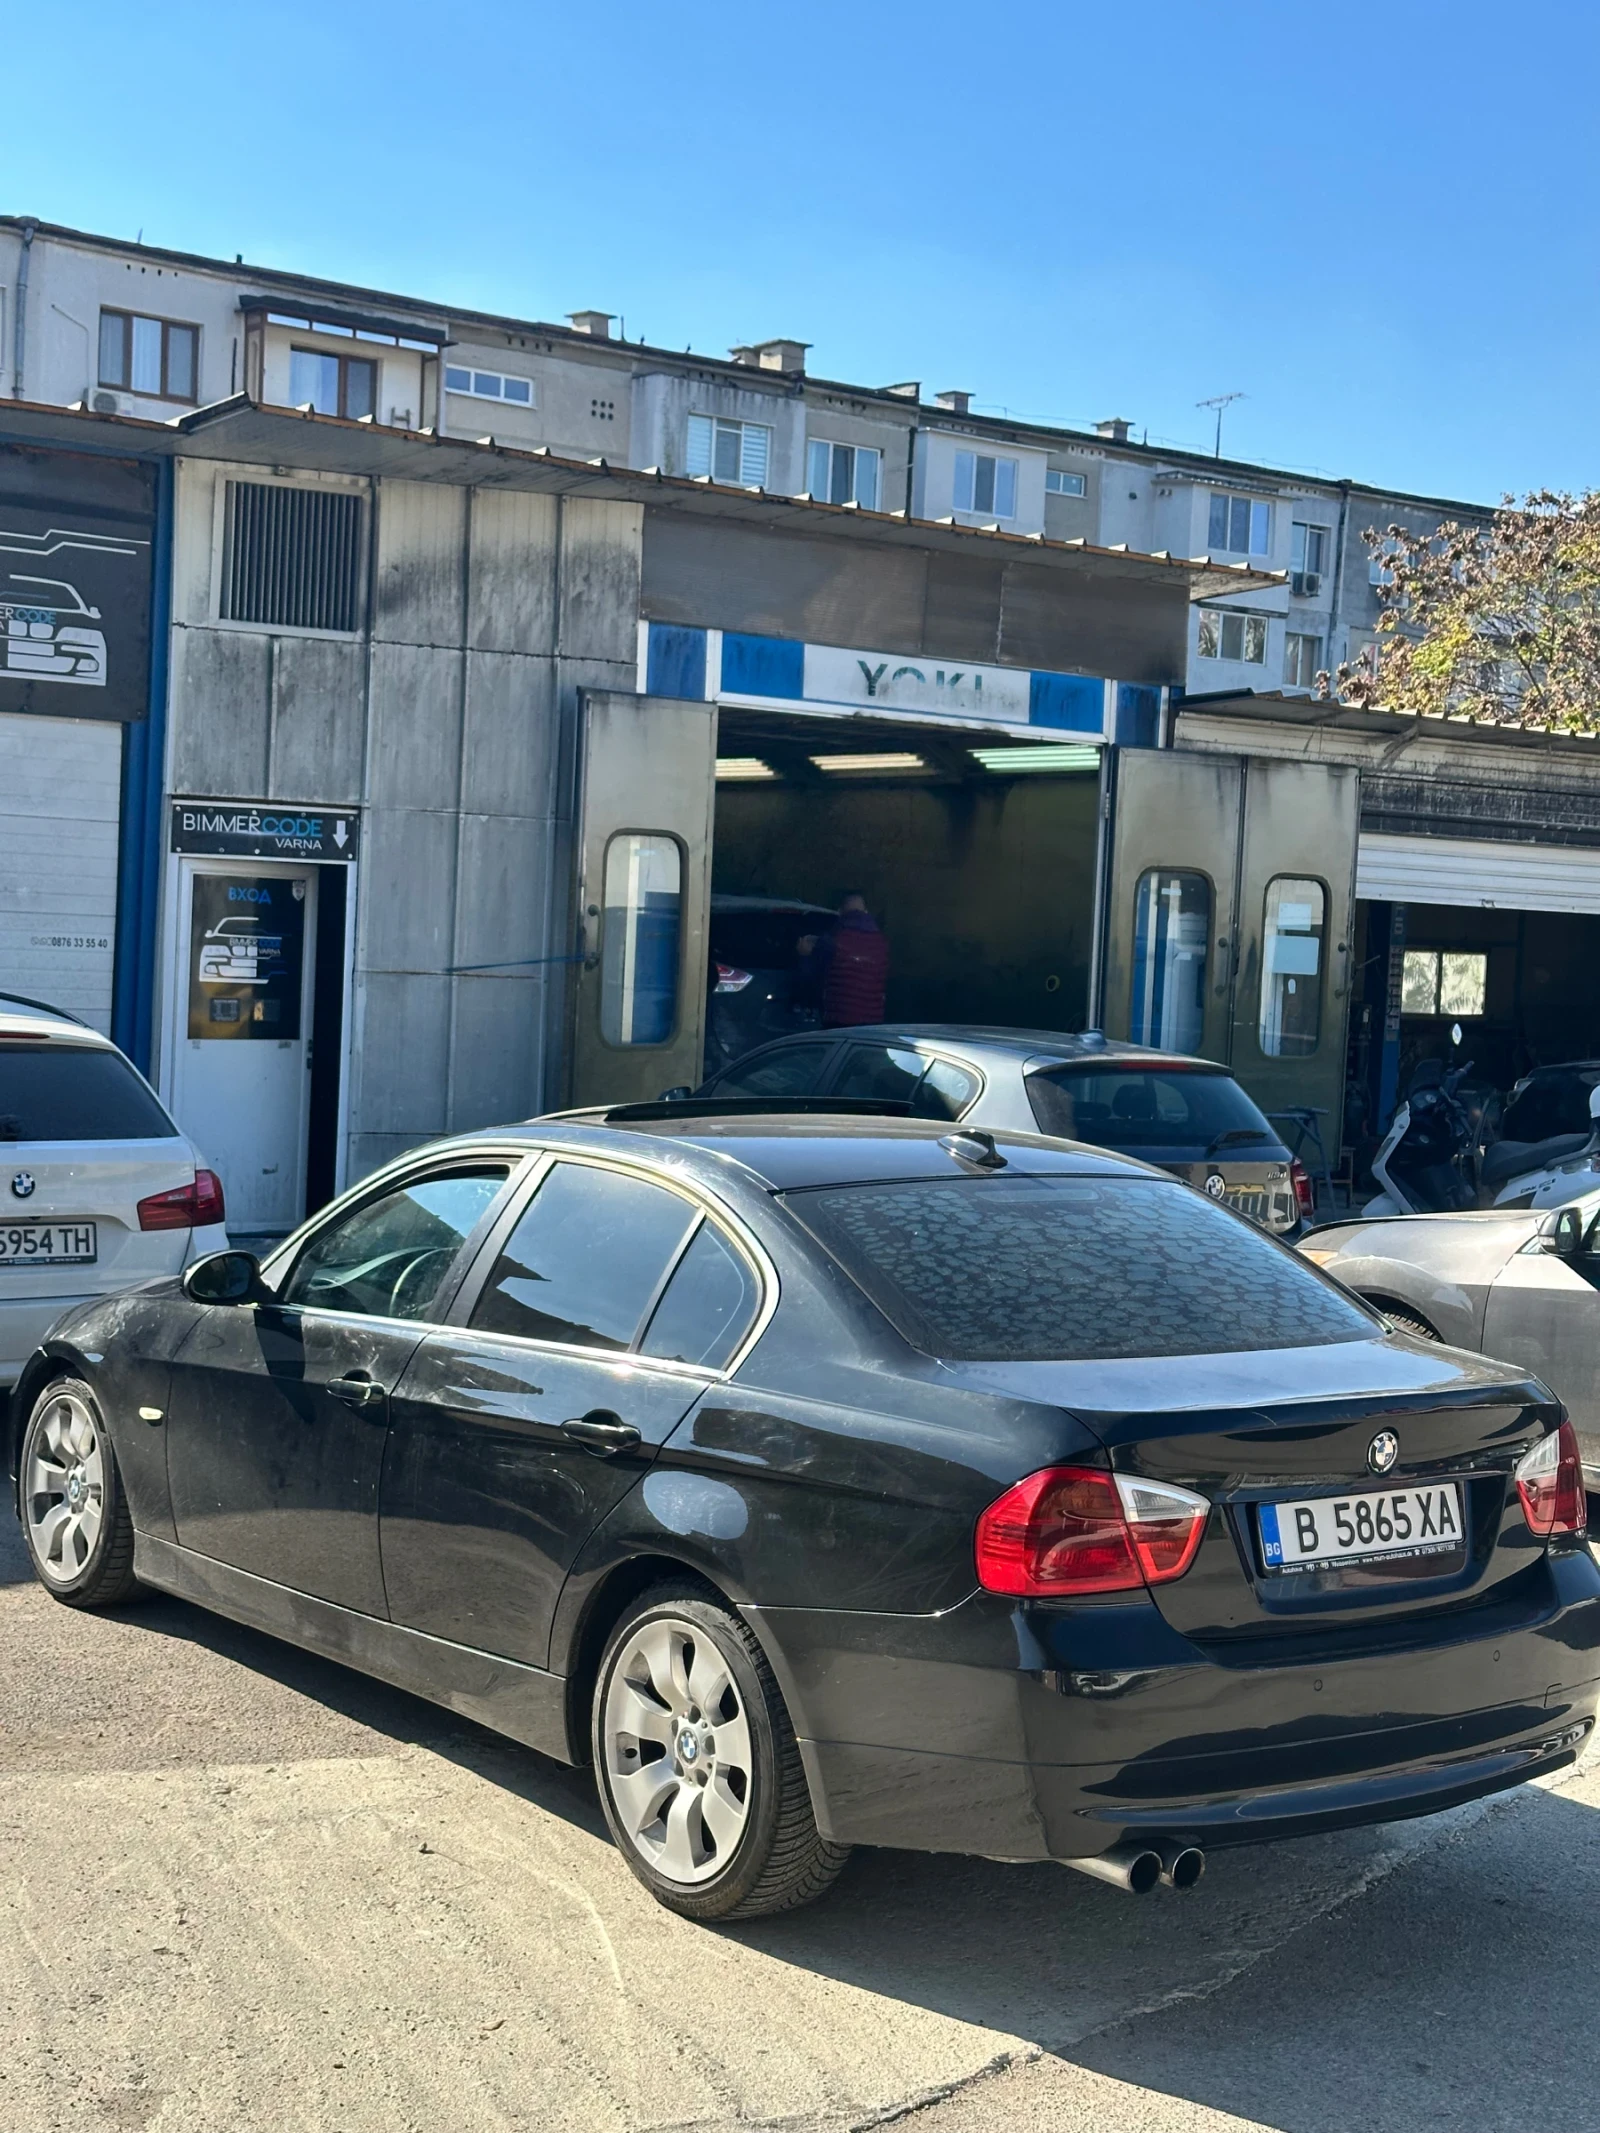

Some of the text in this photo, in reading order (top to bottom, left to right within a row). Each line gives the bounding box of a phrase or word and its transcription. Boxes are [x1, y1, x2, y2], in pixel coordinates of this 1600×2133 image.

[275, 838, 322, 850] VARNA
[51, 936, 108, 948] 0876 33 55 40
[58, 1227, 90, 1253] TH
[1294, 1490, 1456, 1553] B 5865 XA
[1265, 1542, 1280, 1556] BG
